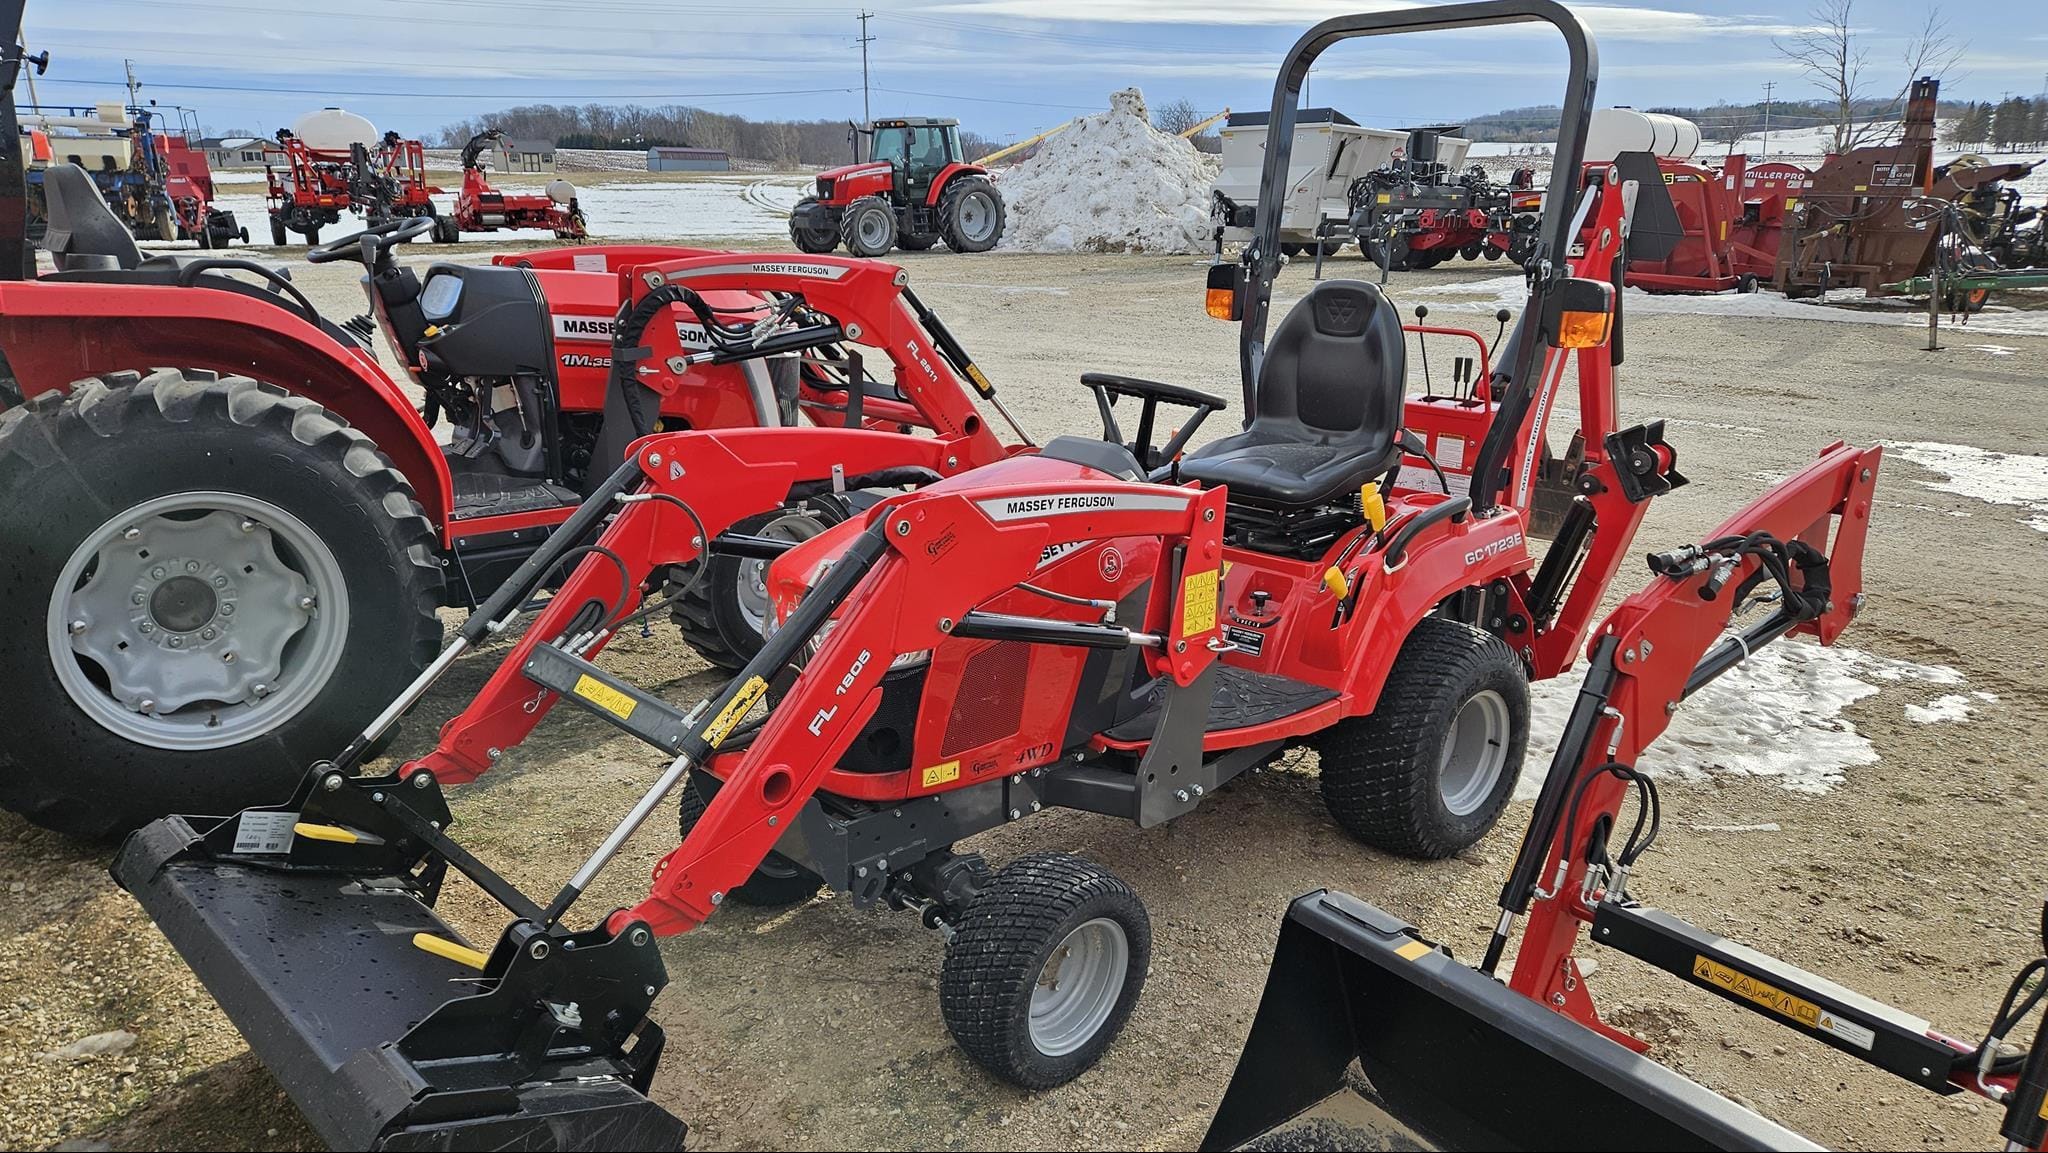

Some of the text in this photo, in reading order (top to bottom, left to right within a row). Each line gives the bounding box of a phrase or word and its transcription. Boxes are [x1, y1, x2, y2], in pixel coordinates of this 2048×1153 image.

[1744, 171, 1805, 180] MILLER PRO
[752, 264, 829, 275] MASSEY FERGUSON
[563, 320, 616, 334] MASSE
[906, 339, 919, 360] FL
[1521, 391, 1548, 491] MASSEY FERGUSON
[1007, 496, 1115, 514] MASSEY FERGUSON
[1464, 532, 1522, 566] GC1723E
[808, 649, 871, 737] FL 1805
[1016, 742, 1053, 764] 4WD
